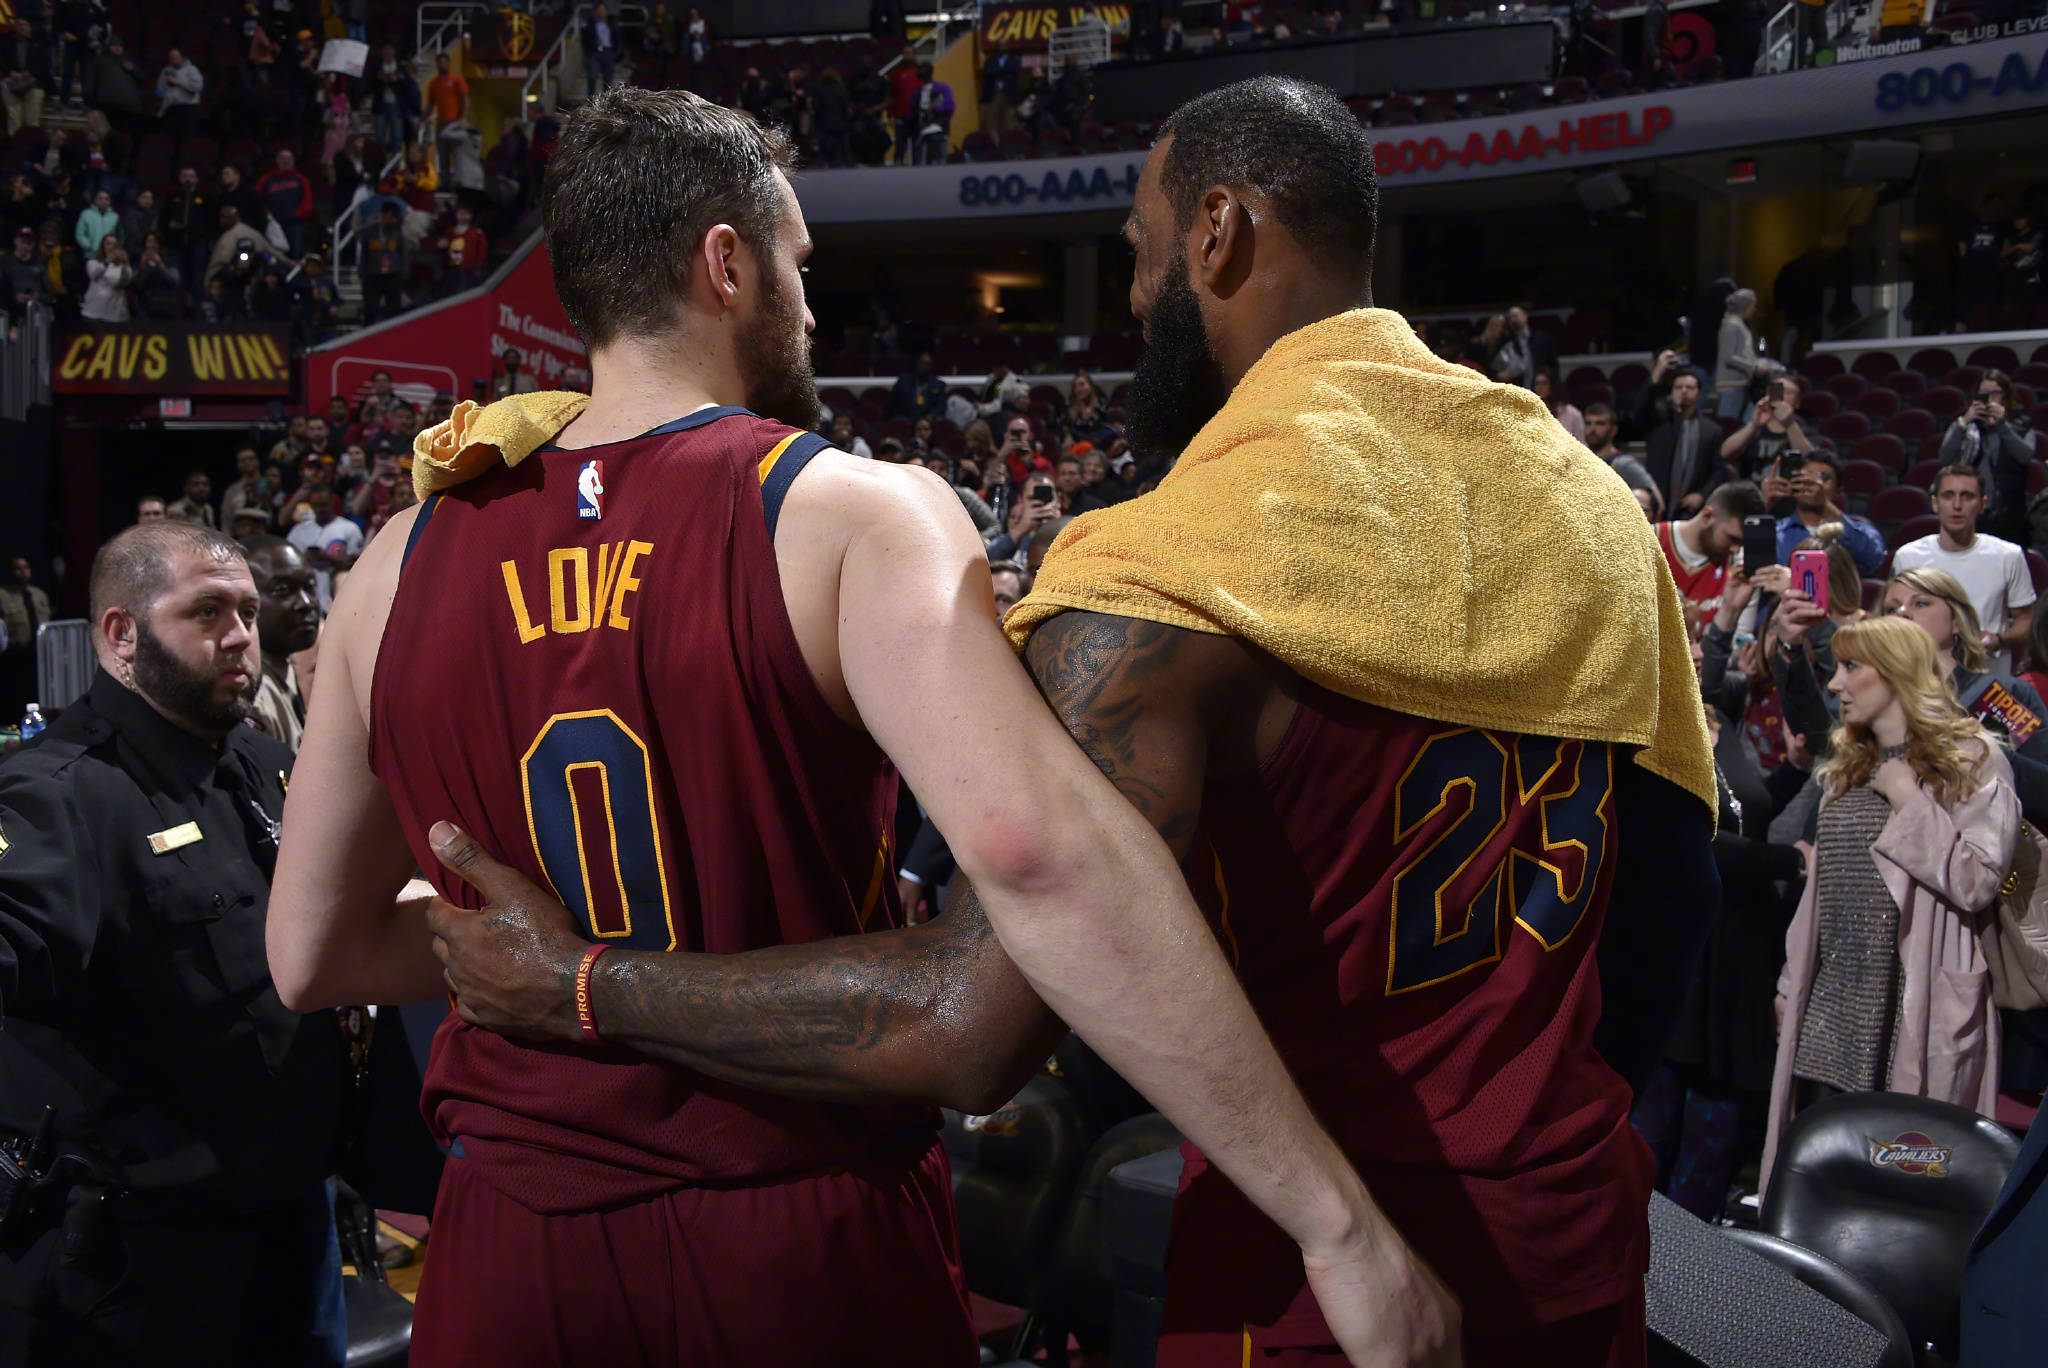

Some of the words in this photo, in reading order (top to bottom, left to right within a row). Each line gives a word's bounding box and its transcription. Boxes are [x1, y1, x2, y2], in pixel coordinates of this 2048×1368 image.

[987, 8, 1059, 41] CAVS
[1951, 24, 1999, 45] CLUB
[1836, 37, 1922, 63] Huntington
[1373, 106, 1672, 175] 800-AAA-HELP
[499, 303, 521, 332] The
[60, 334, 168, 380] CAVS
[187, 334, 289, 380] WIN!
[580, 508, 597, 517] NBA
[501, 539, 655, 645] LOVE
[1983, 682, 2041, 736] TIPOFF
[520, 708, 677, 952] 0
[1385, 727, 1608, 996] 23
[577, 953, 594, 1021] PROMISE
[1874, 1144, 1947, 1166] CAVALIERS
